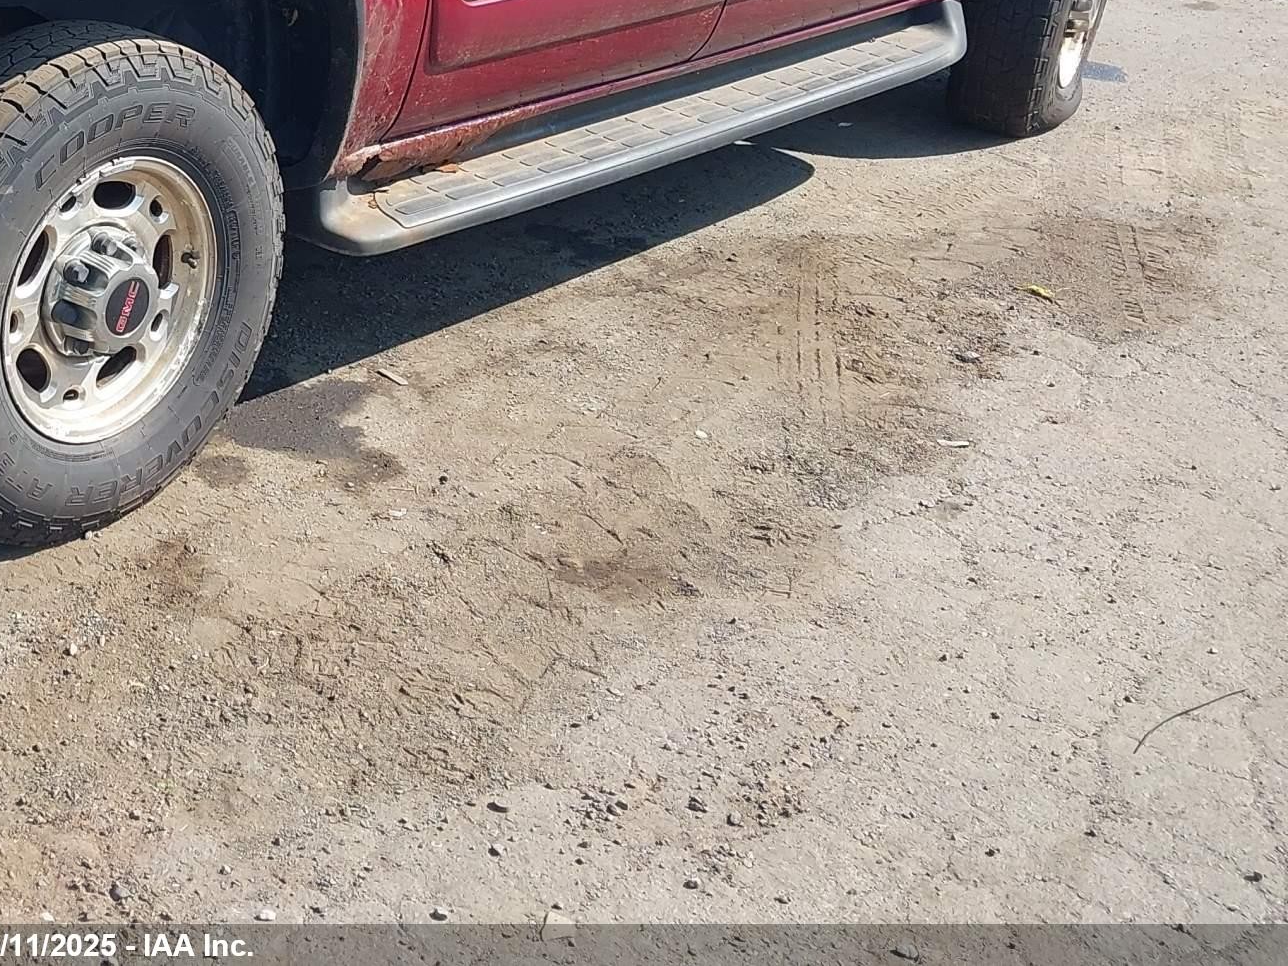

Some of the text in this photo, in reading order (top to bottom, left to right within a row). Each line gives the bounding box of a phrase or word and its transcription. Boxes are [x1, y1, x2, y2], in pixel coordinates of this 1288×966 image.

[35, 102, 196, 191] COOPER
[115, 280, 140, 333] GMC
[64, 320, 253, 507] DISCOVERER
